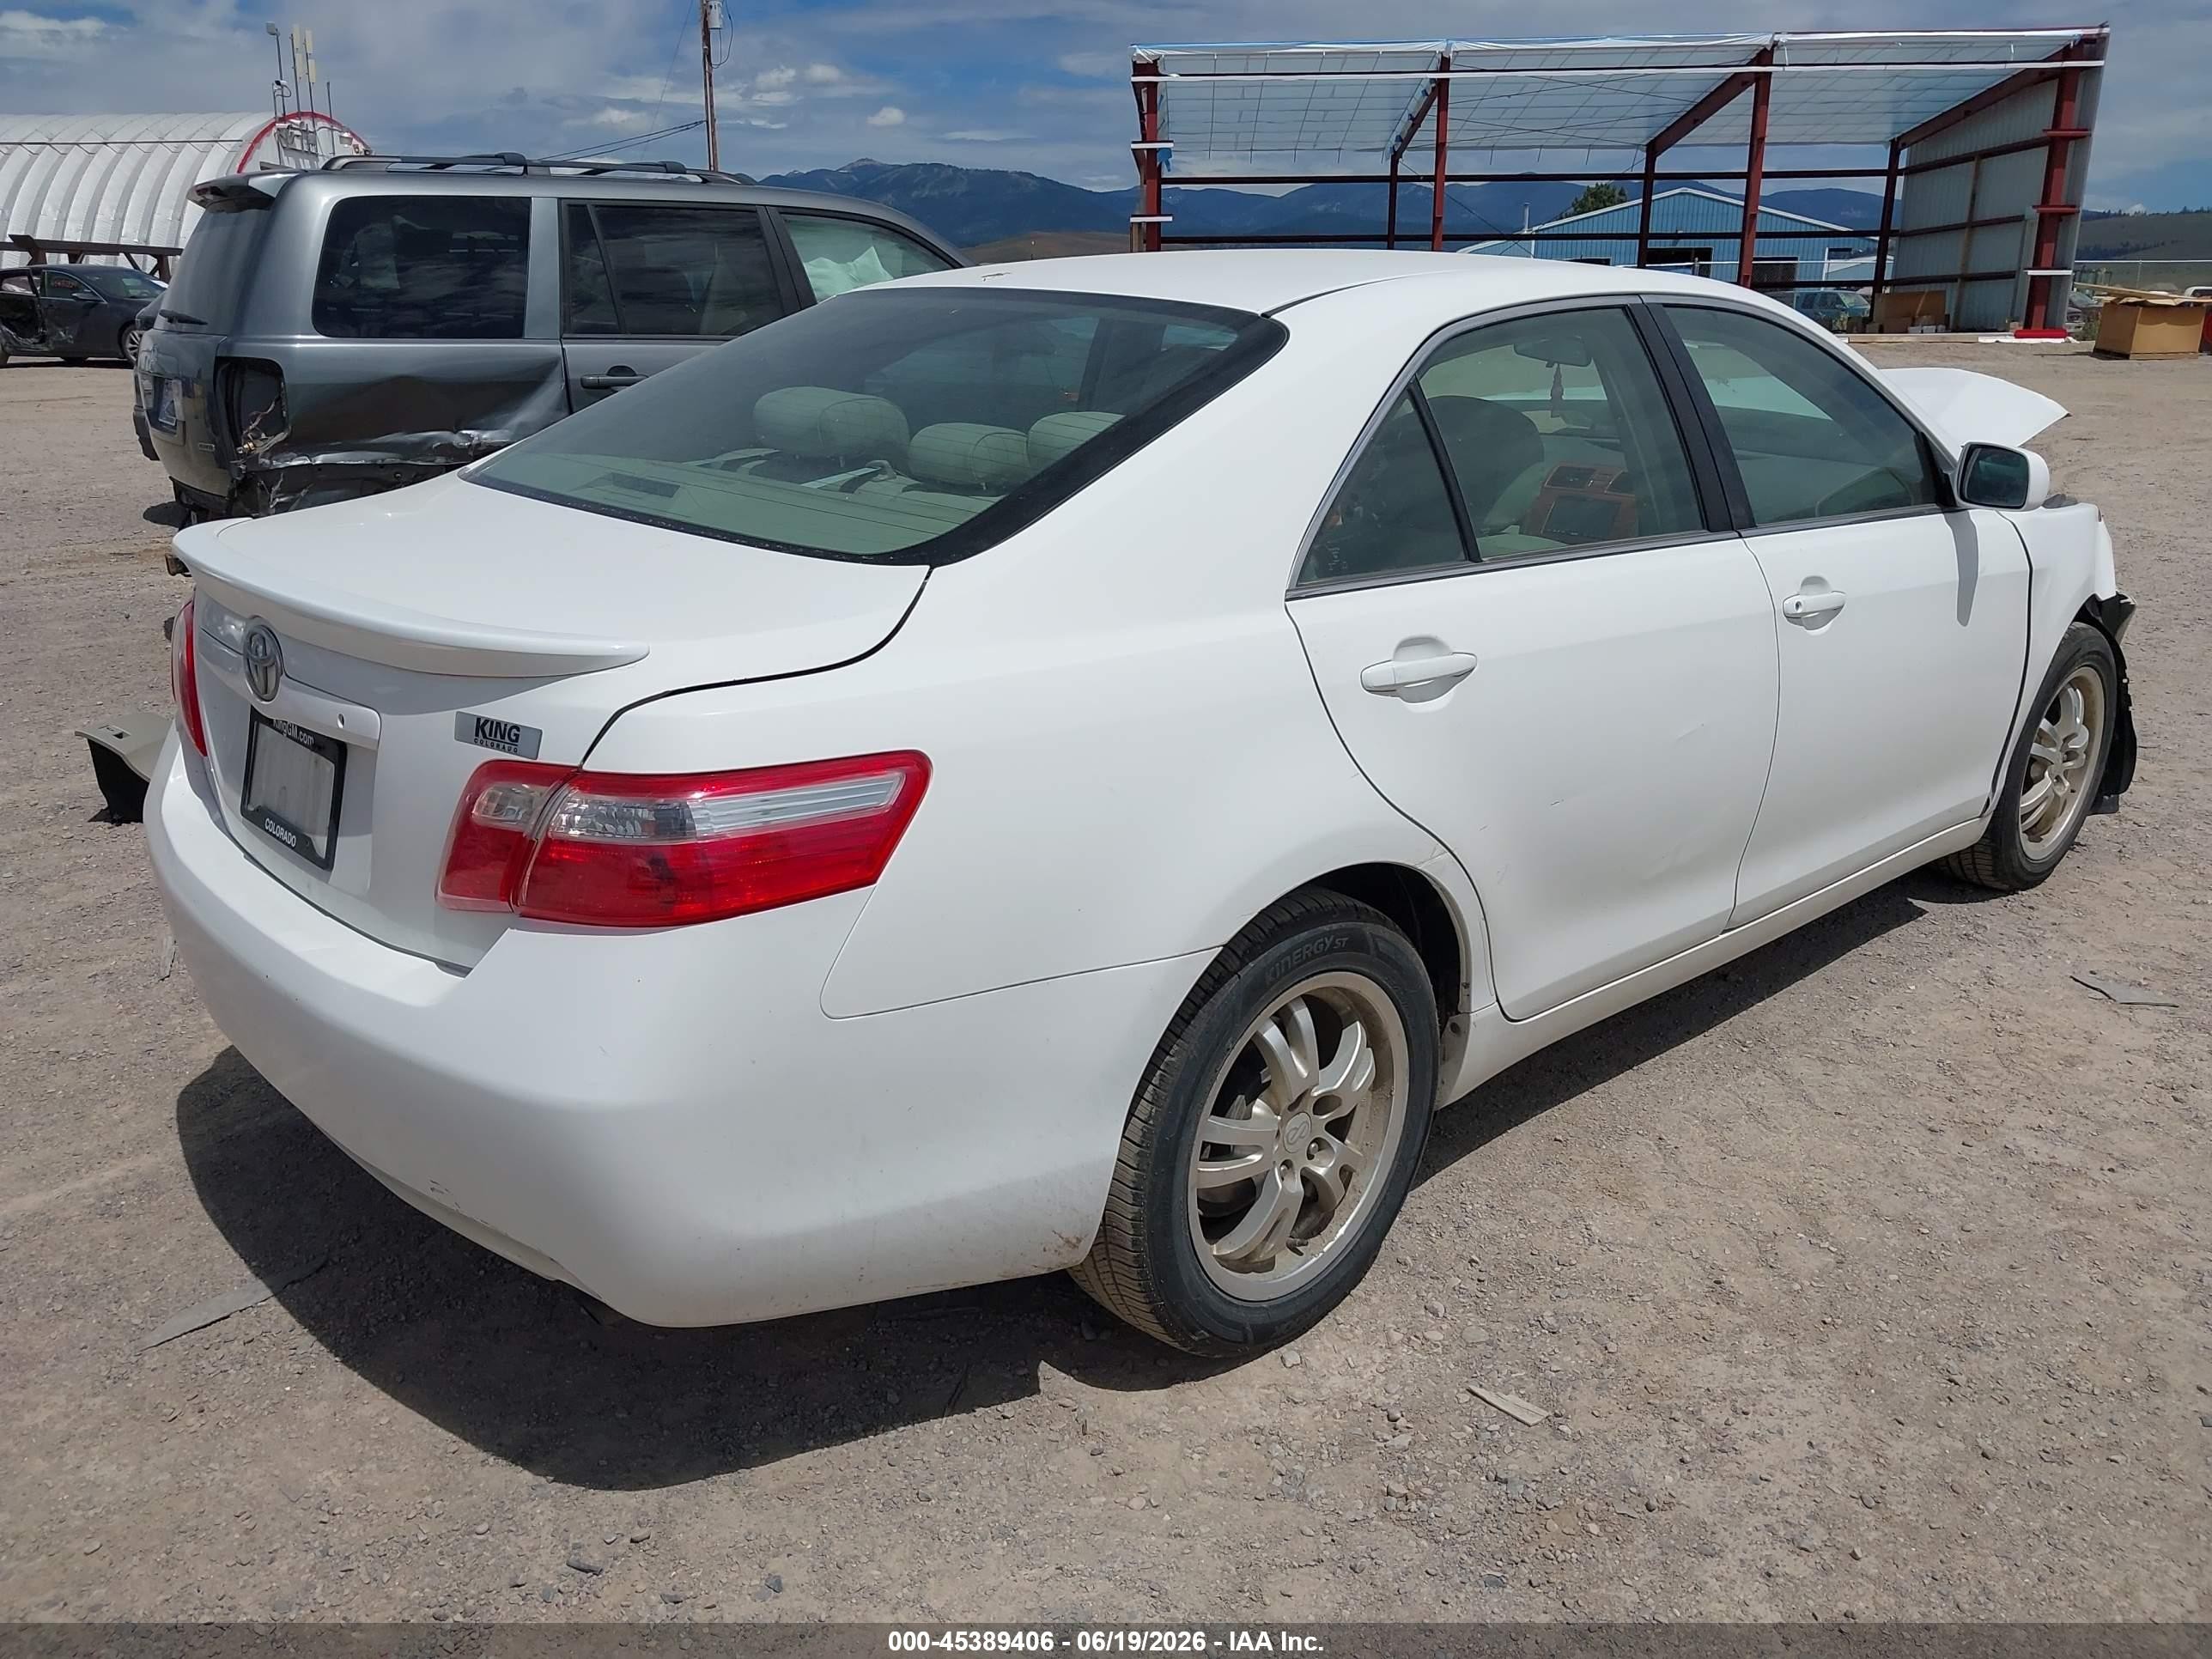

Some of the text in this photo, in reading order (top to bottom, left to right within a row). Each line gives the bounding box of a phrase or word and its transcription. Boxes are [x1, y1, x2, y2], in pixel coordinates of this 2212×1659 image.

[475, 716, 521, 744] KING
[473, 738, 519, 754] COLORADO
[264, 817, 297, 848] COLORADO
